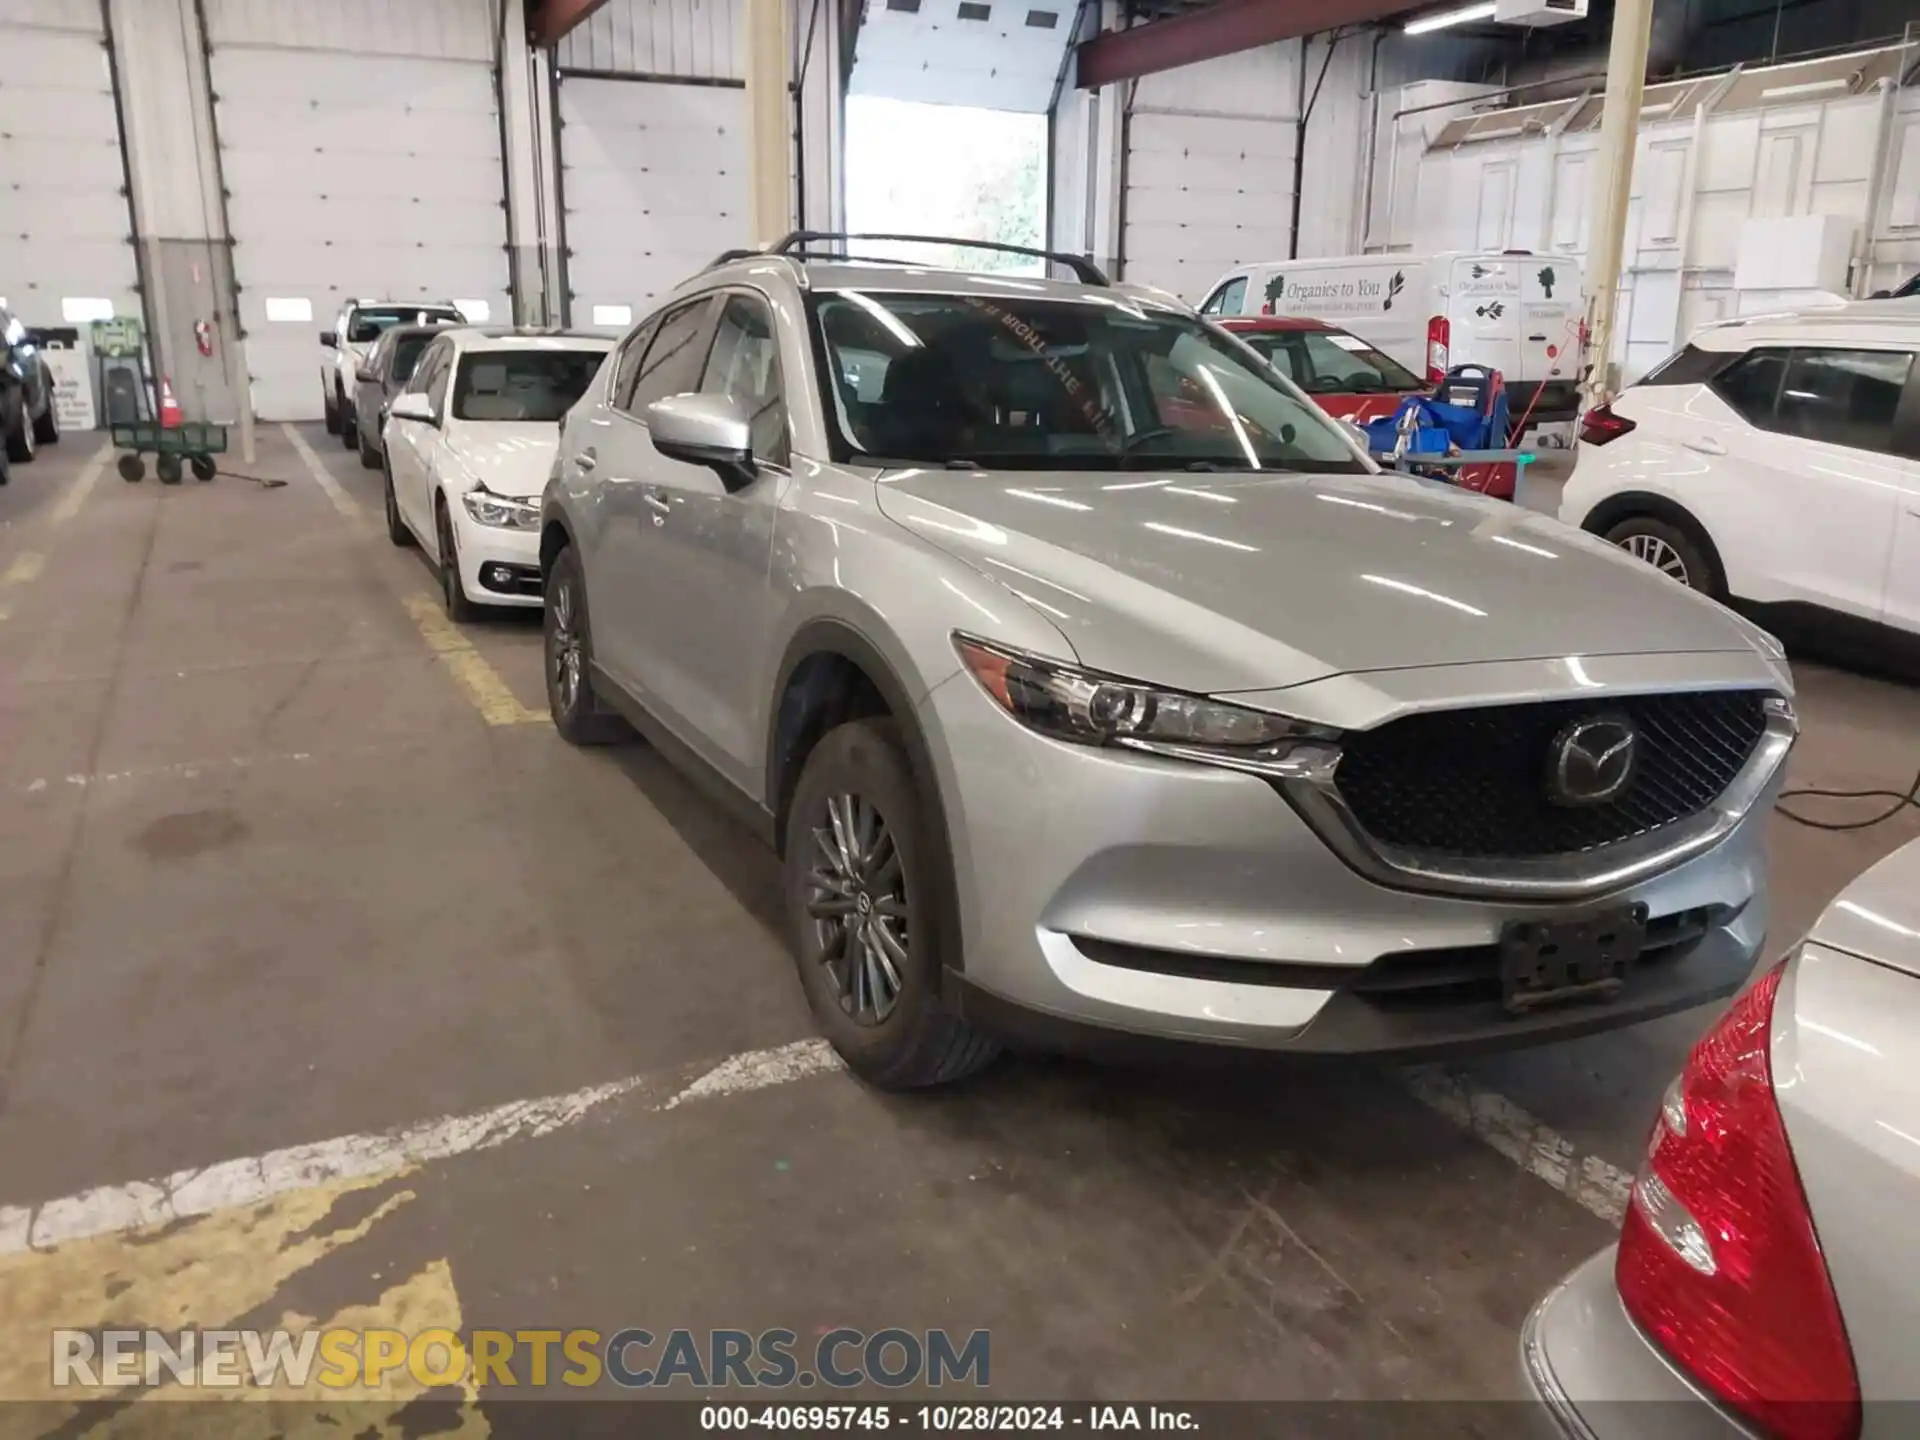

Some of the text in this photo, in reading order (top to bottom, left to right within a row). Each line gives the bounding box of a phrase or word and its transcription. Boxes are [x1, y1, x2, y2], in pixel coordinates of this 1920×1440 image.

[1286, 279, 1380, 302] Organics to You
